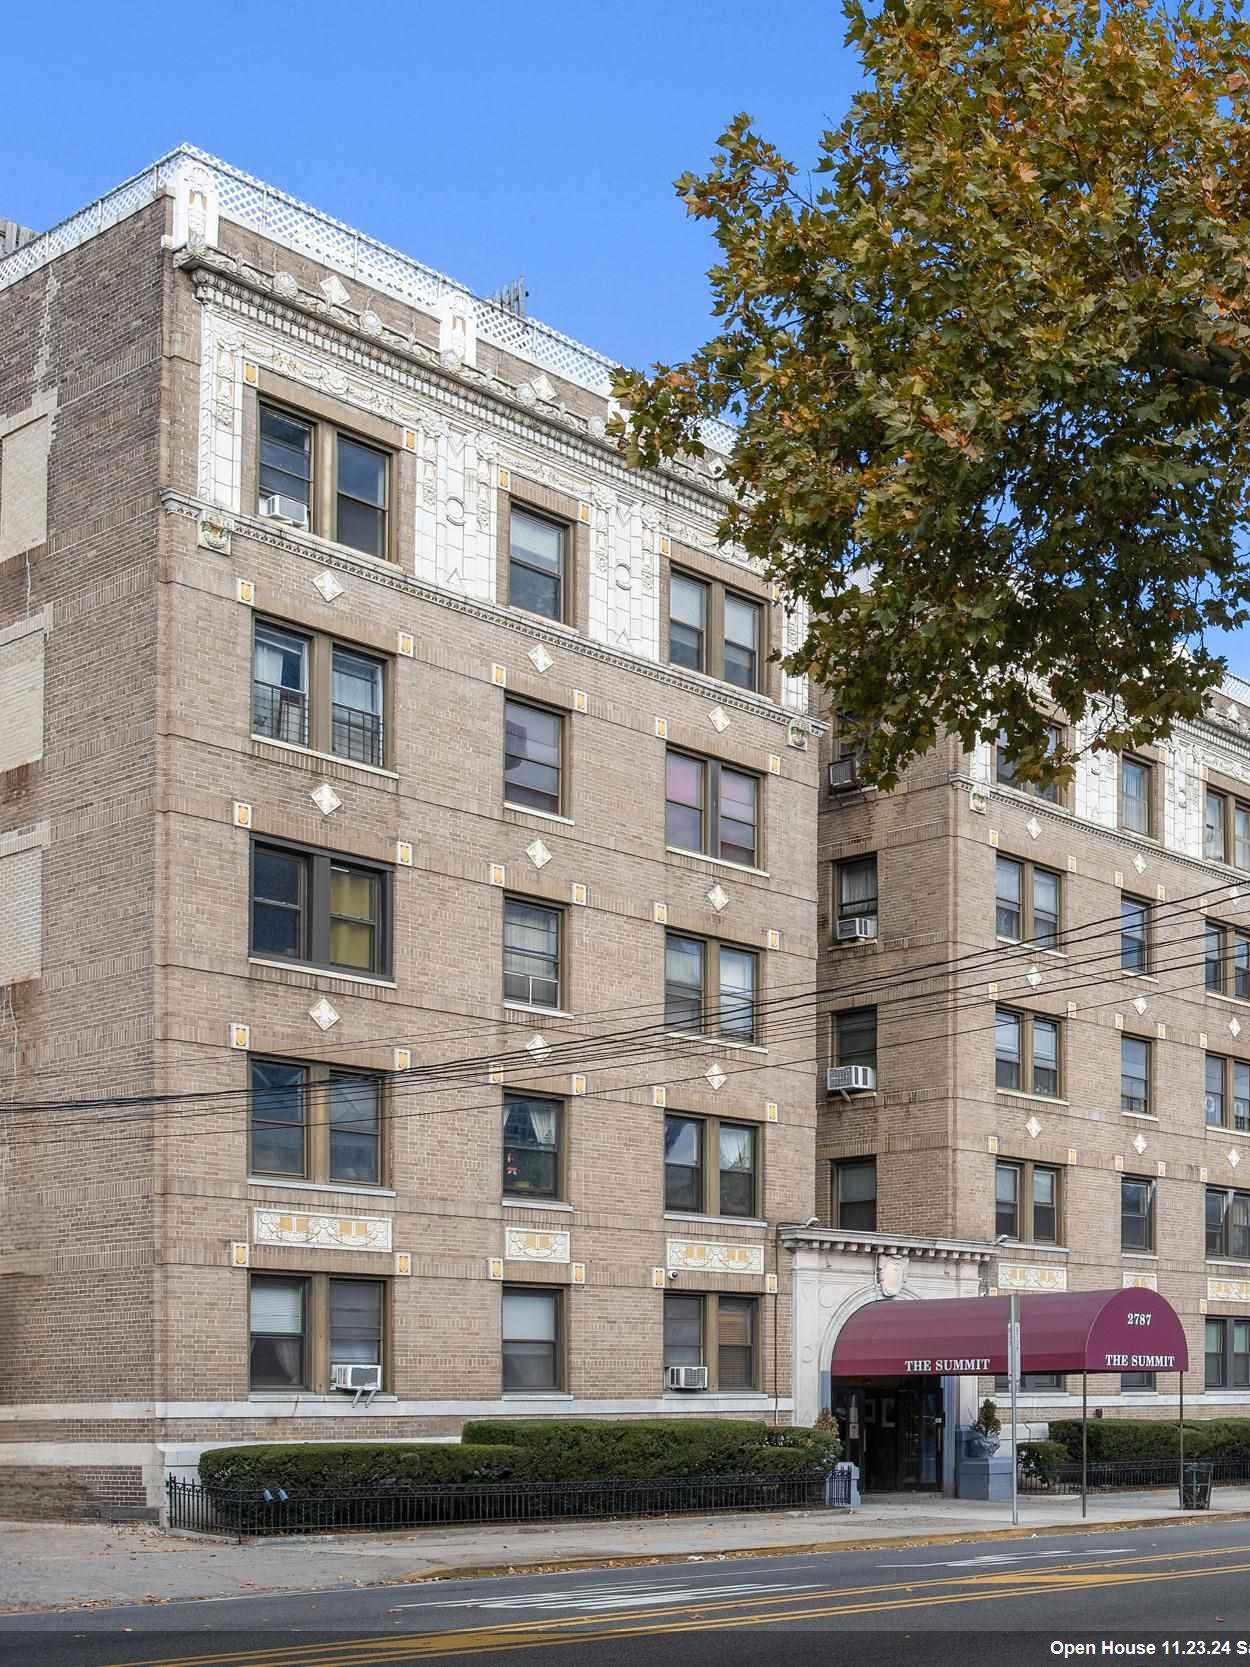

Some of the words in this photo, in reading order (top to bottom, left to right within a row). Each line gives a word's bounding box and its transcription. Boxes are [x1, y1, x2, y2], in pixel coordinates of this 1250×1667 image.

[1127, 1312, 1152, 1326] 2787
[904, 1359, 932, 1372] THE
[935, 1358, 991, 1371] SUMMIT
[1105, 1354, 1129, 1367] THE
[1131, 1355, 1176, 1367] SUMMIT
